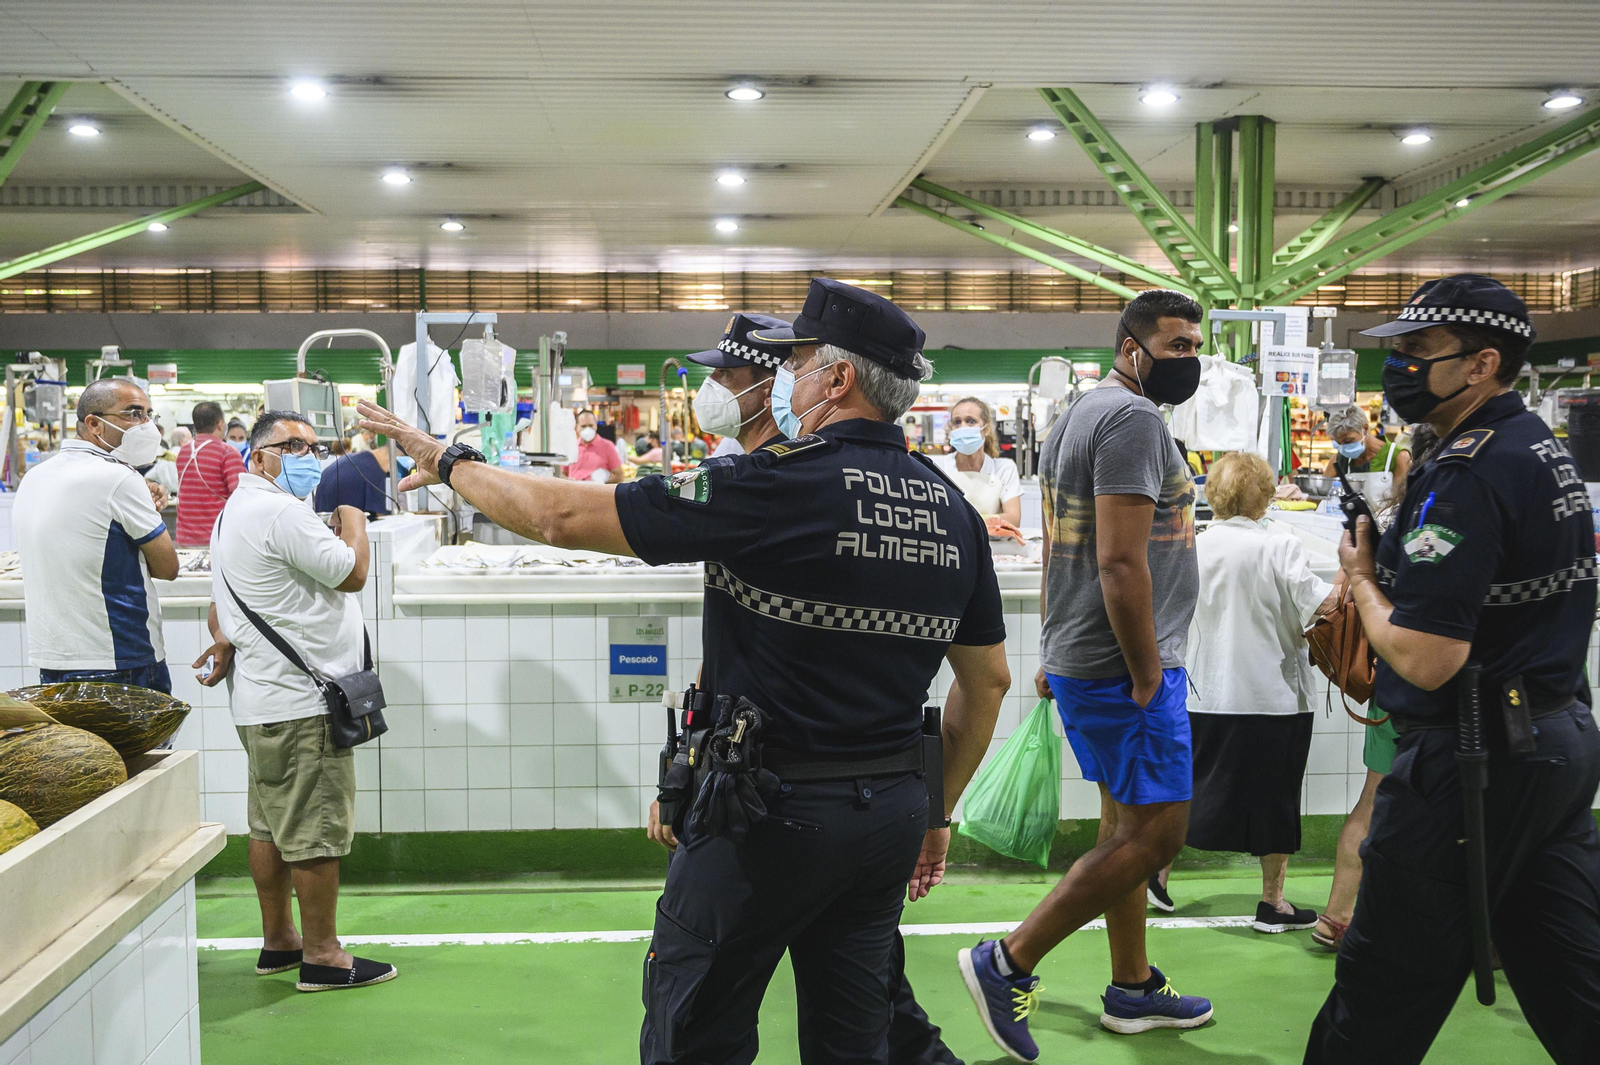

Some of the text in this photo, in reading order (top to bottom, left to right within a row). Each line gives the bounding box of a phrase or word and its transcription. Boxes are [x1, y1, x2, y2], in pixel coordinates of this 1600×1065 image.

[842, 468, 950, 507] POLICIA
[856, 499, 947, 536] LOCAL
[835, 531, 960, 570] ALMERIA
[619, 655, 658, 664] Pescado
[629, 684, 664, 697] P-22
